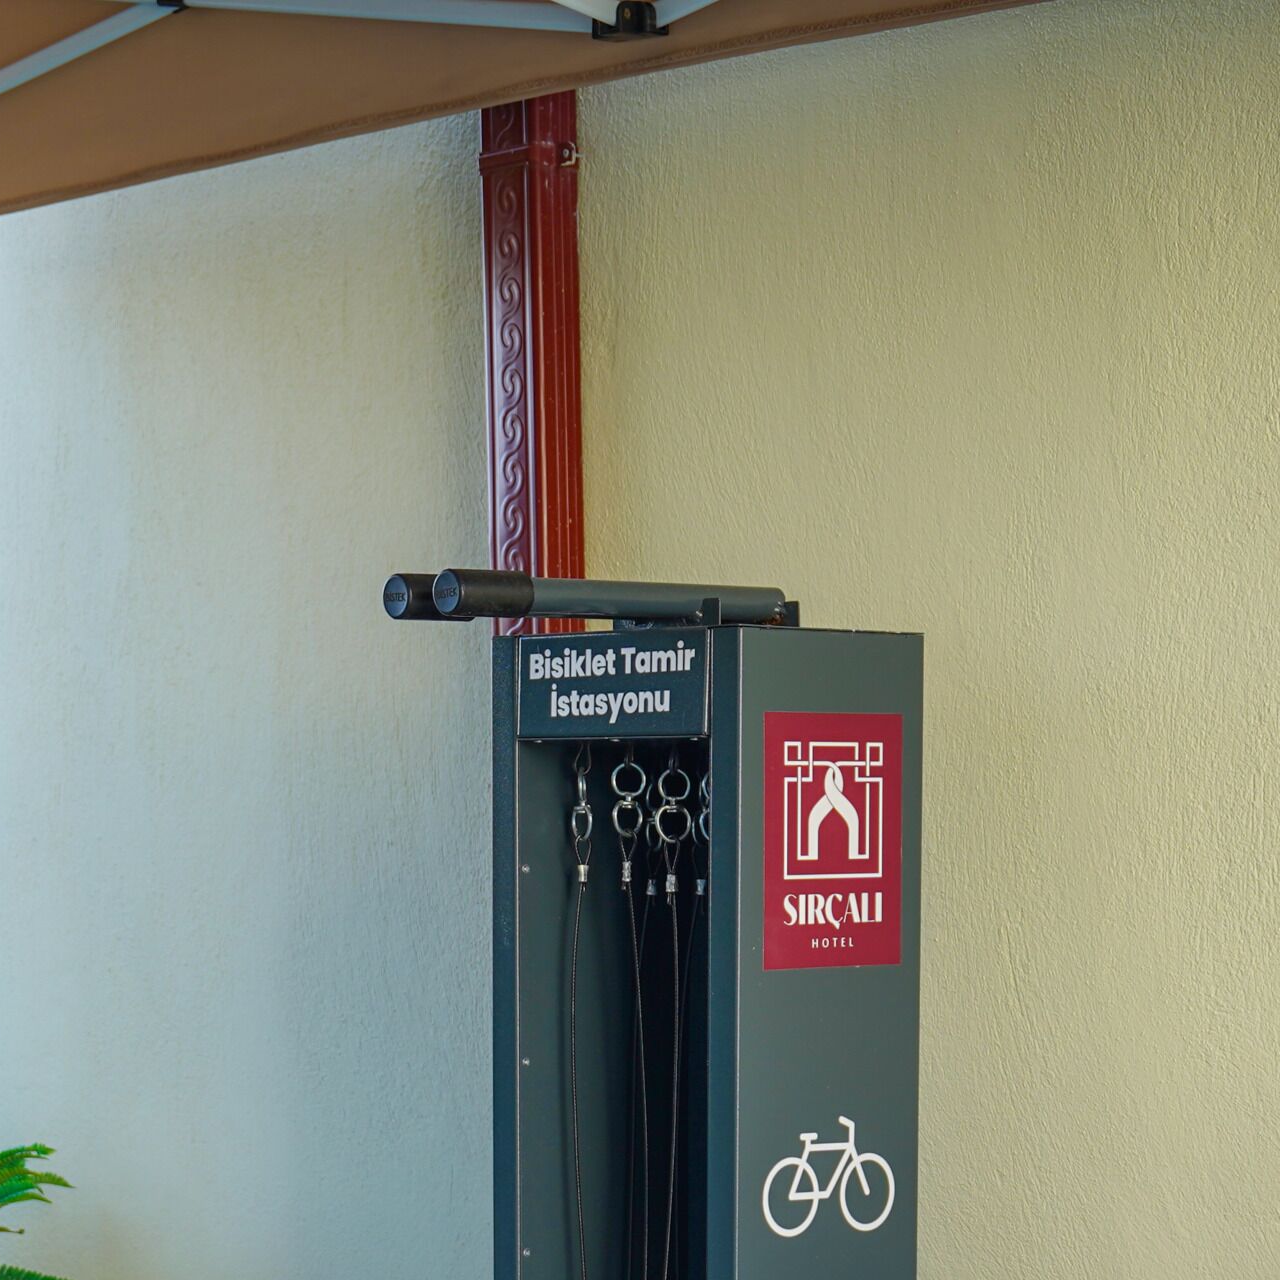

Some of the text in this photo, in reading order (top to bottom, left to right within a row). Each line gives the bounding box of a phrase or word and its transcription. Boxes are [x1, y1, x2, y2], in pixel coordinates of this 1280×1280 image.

[529, 640, 696, 680] Bisiklet Tamir
[550, 683, 671, 724] İstasyonu
[783, 892, 883, 930] SIRÇALI
[811, 937, 854, 949] HOTEL
